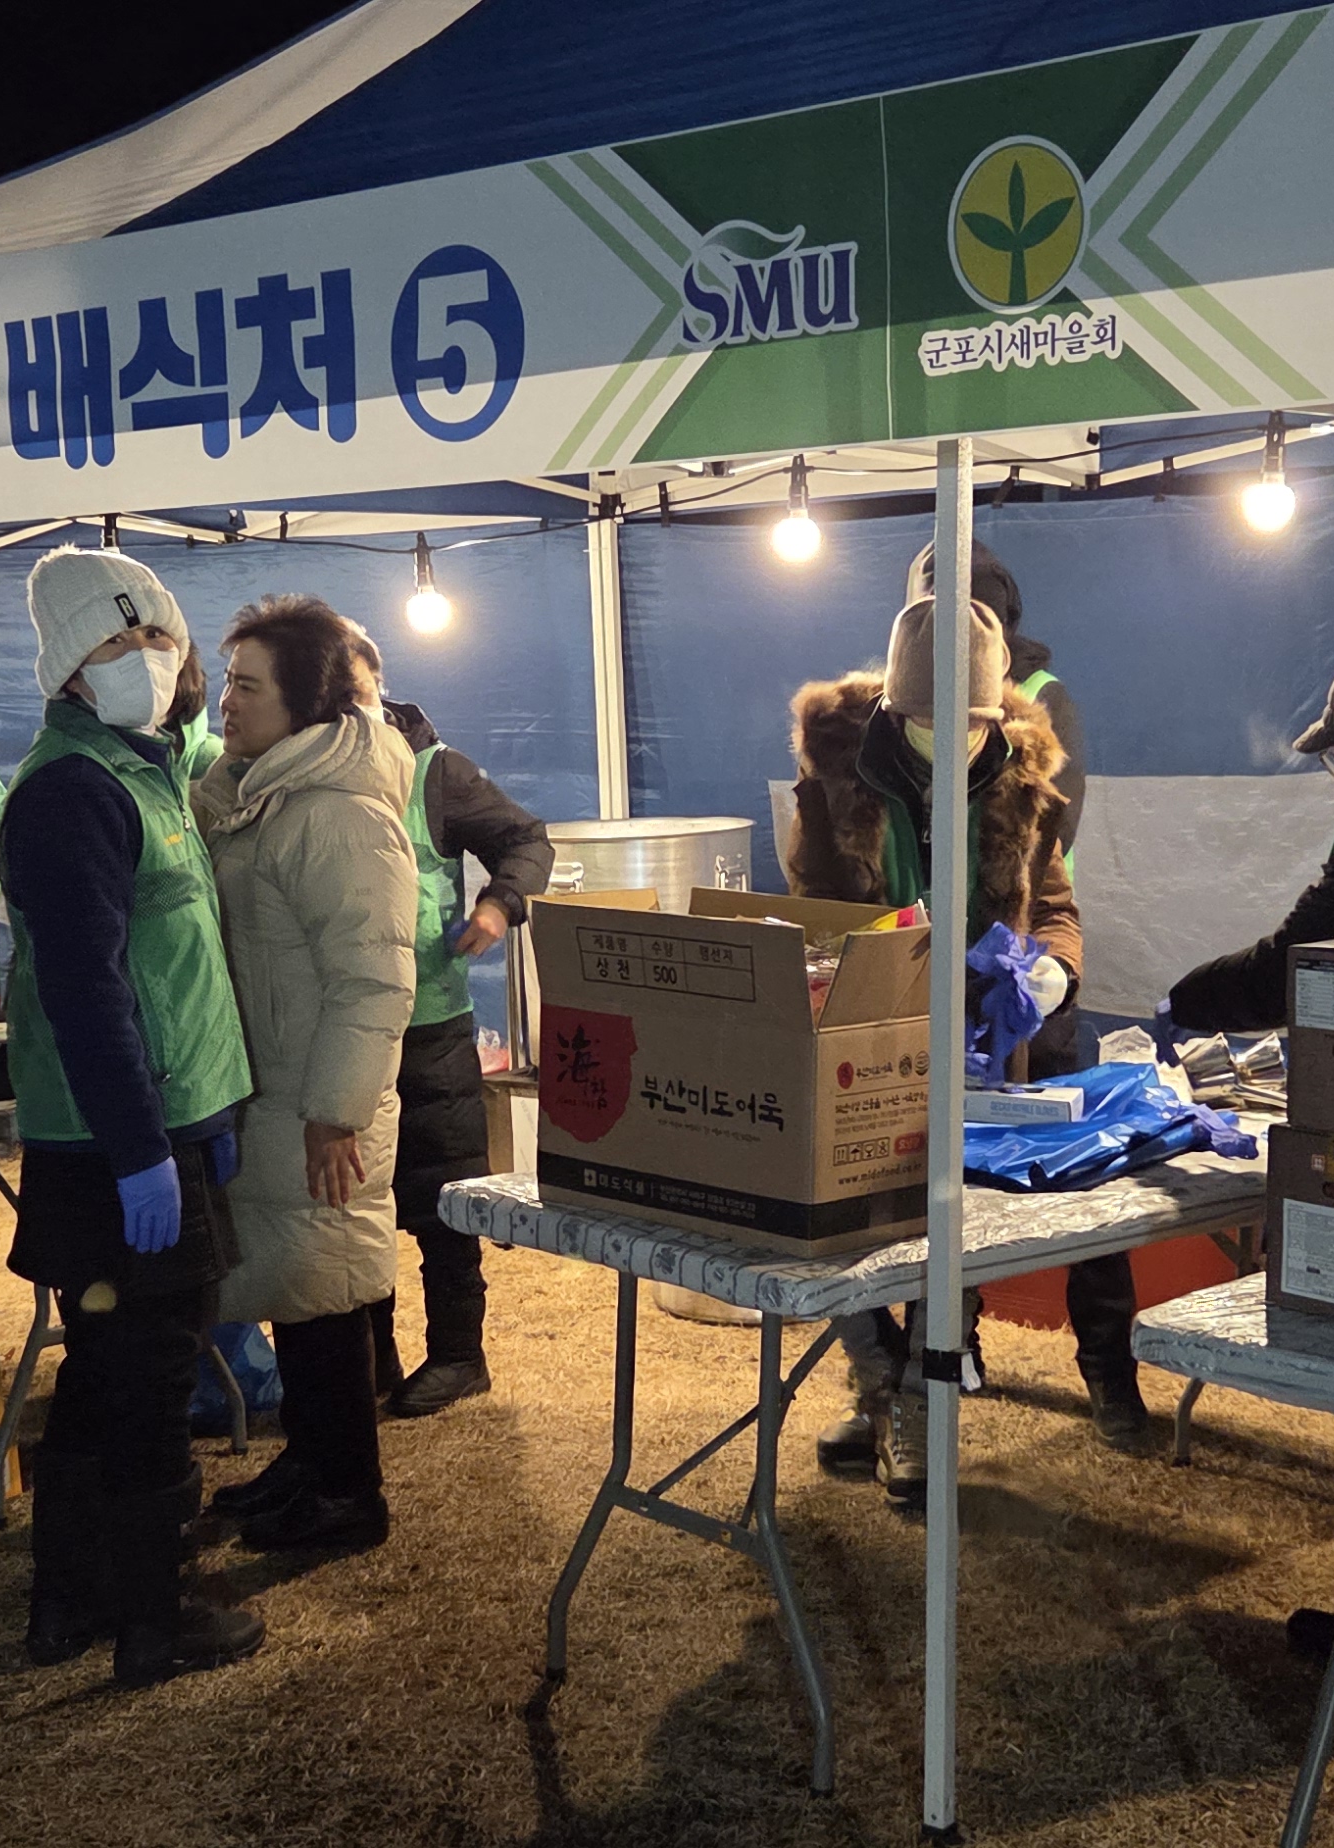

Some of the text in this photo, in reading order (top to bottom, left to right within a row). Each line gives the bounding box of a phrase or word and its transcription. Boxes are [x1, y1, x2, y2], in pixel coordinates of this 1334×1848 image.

[682, 244, 856, 343] SMU
[4, 267, 359, 470] 배식처
[923, 314, 1118, 371] 군포시새마을회
[653, 965, 677, 985] 500
[640, 1074, 784, 1132] 부산미도어묵
